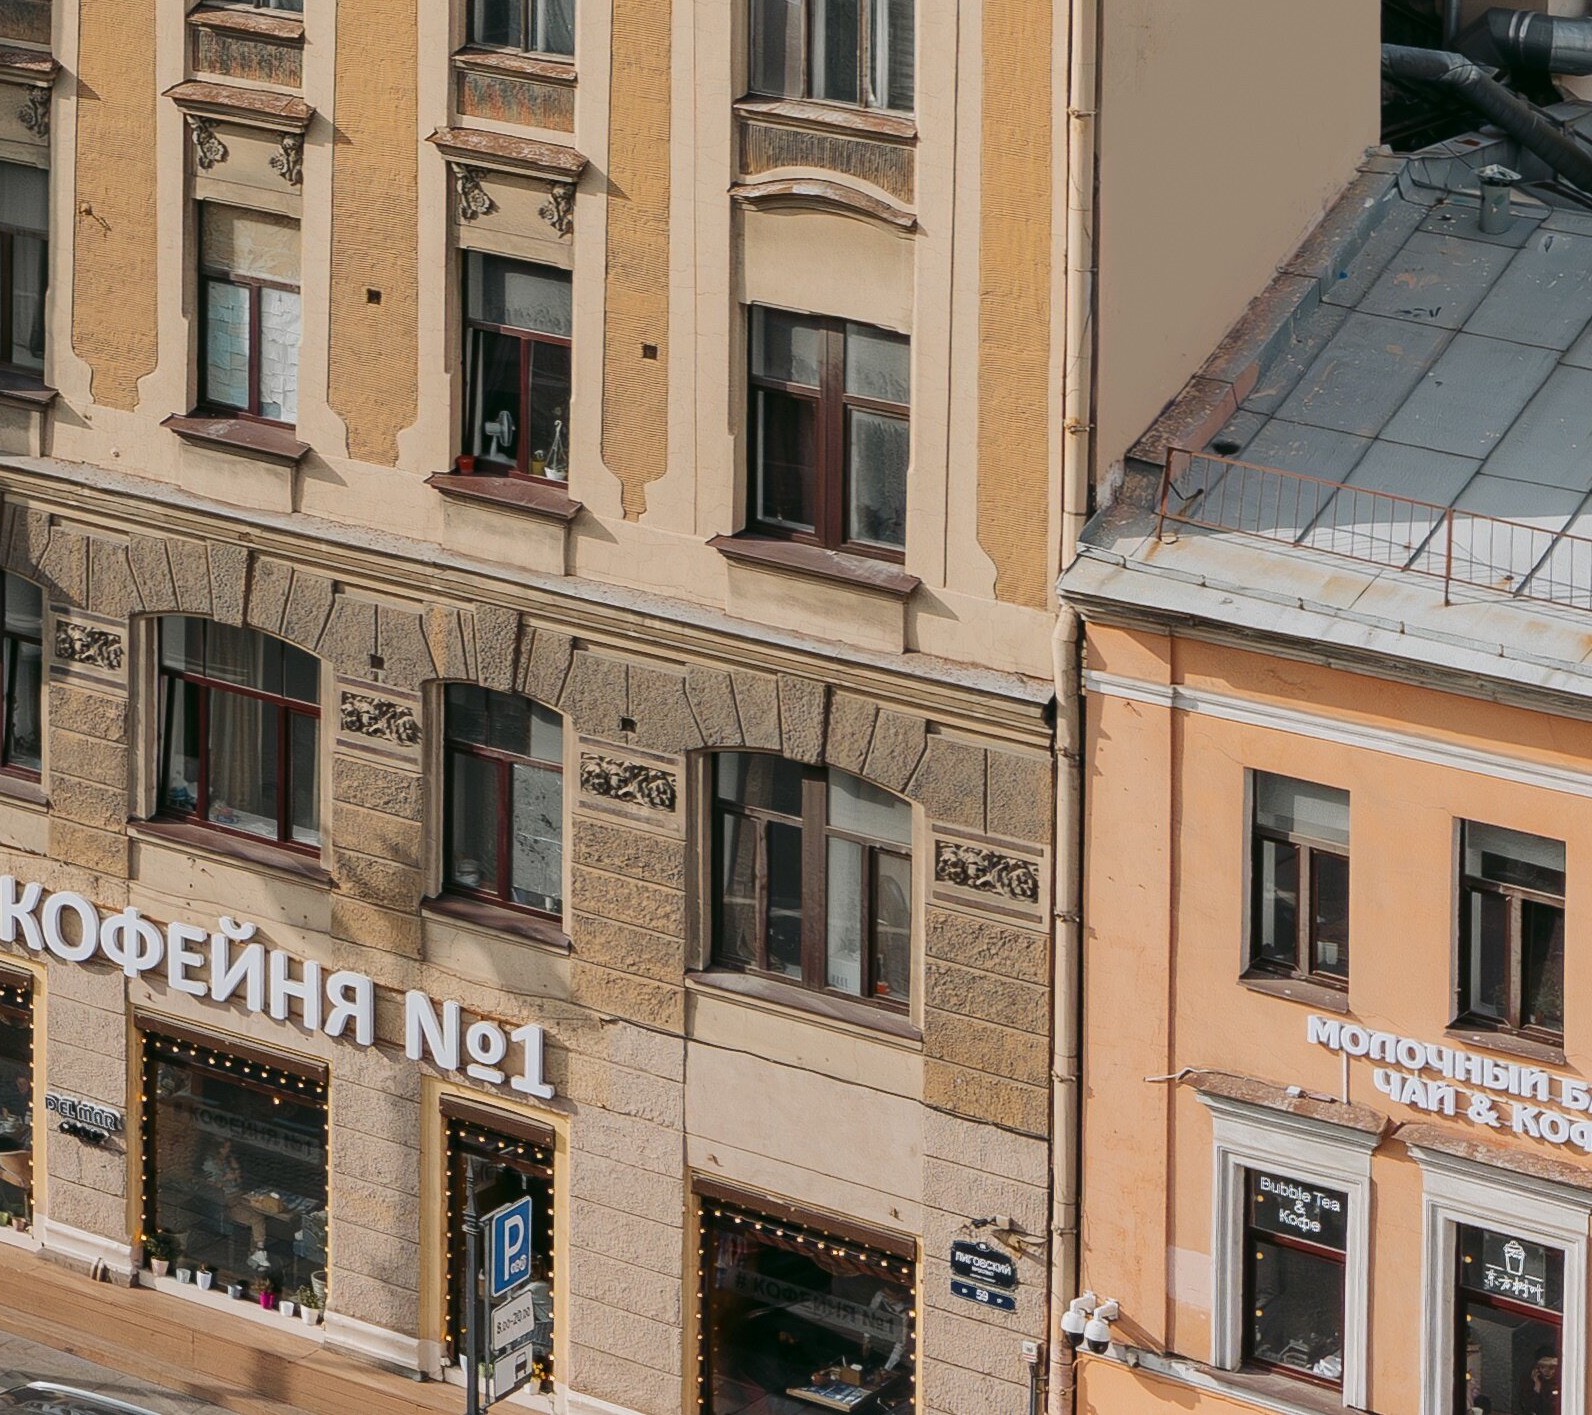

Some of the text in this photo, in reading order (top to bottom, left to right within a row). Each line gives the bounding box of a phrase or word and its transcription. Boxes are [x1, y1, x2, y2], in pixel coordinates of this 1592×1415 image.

[1307, 1014, 1592, 1114] МОЛОЧНЫЙ Б
[1373, 1068, 1456, 1117] ЧАЙ
[1467, 1092, 1502, 1129] &
[1260, 1176, 1341, 1212] Bubble Tea
[1293, 1200, 1306, 1215] &
[1279, 1208, 1321, 1233] Кофе
[955, 1251, 1012, 1276] ЛИГОВСКИЙ
